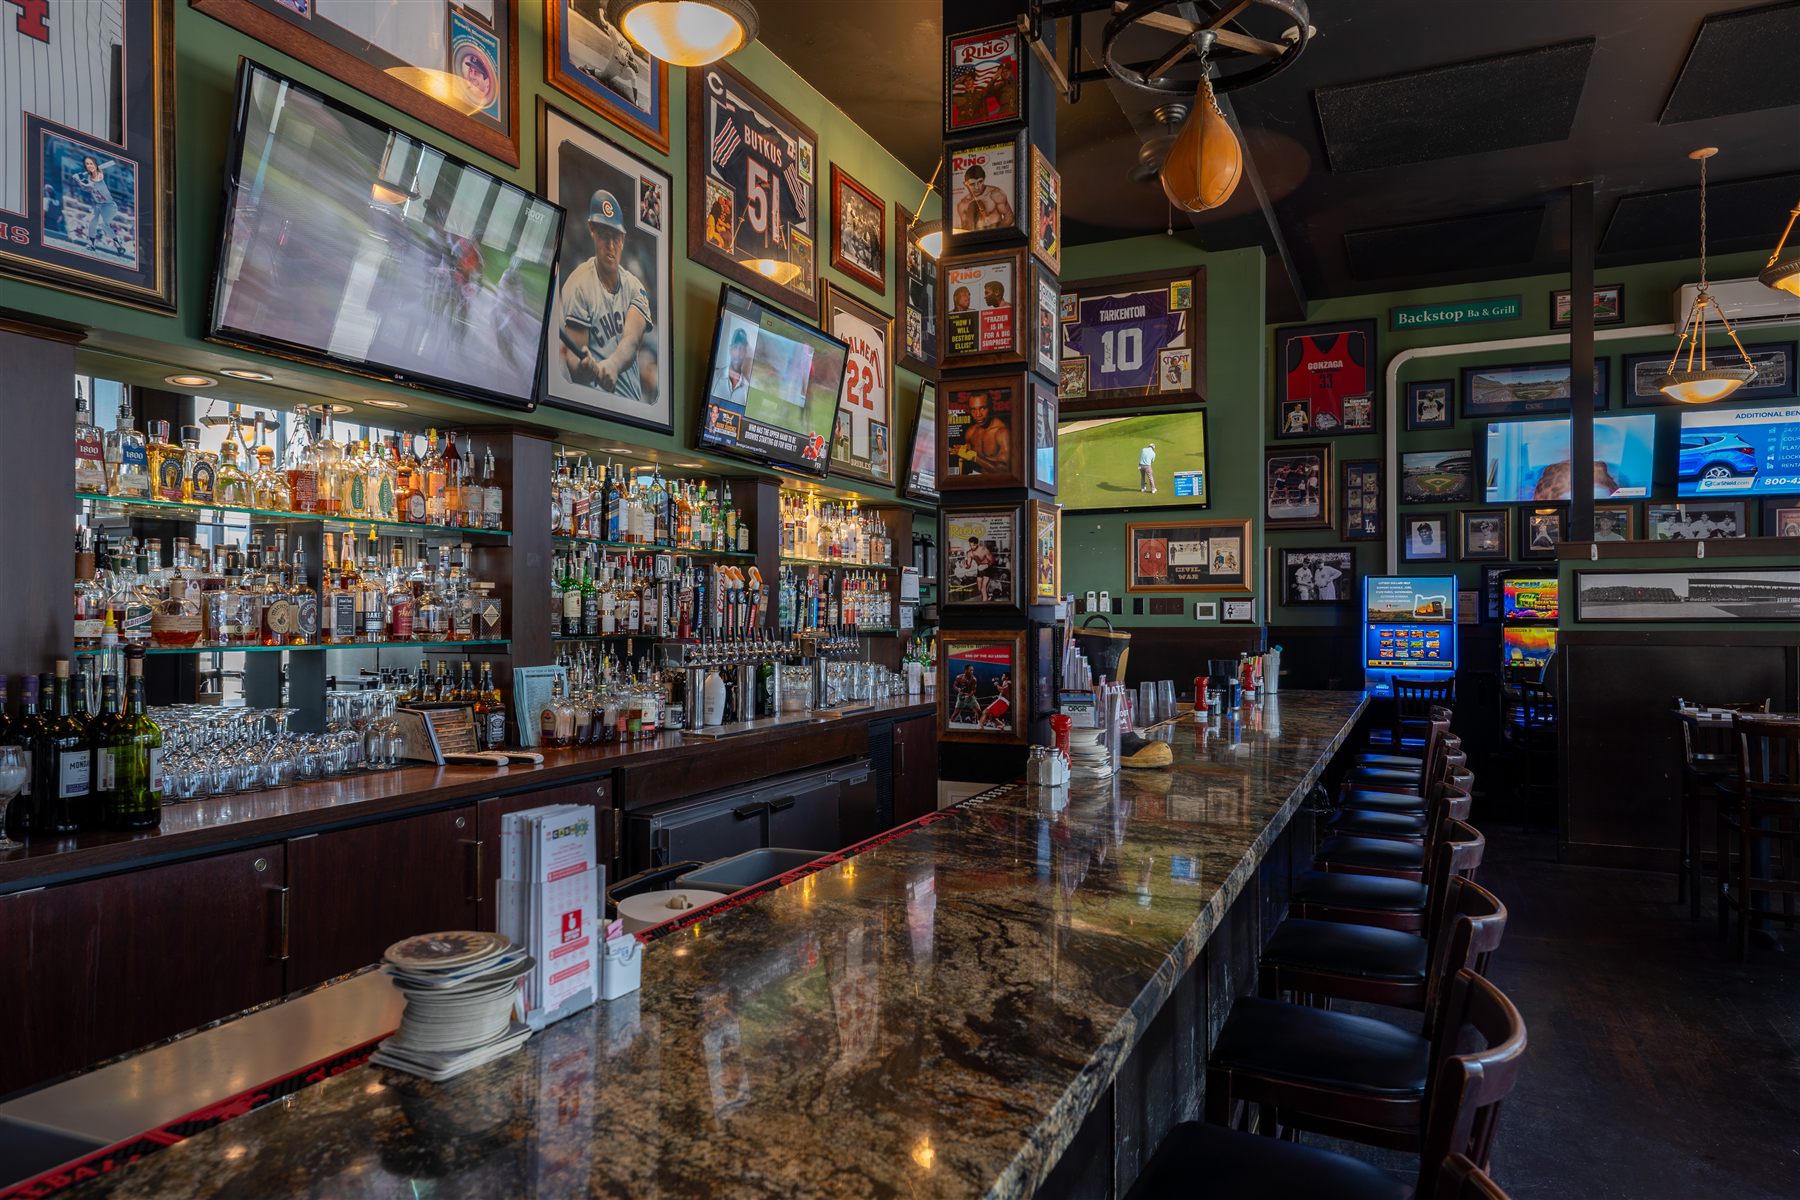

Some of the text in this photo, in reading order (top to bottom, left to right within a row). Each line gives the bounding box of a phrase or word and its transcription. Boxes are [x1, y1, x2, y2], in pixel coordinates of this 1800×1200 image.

[961, 42, 1006, 63] RING
[744, 124, 783, 168] BUTKUS
[952, 156, 986, 172] RING
[746, 156, 781, 244] 51
[524, 207, 546, 222] ROOT
[948, 269, 982, 285] RING
[1099, 305, 1146, 322] TARKENTON
[1398, 305, 1516, 325] Backstop Ba & Grill
[591, 311, 627, 349] CHIC
[951, 334, 975, 343] DESTROY
[1101, 327, 1143, 374] 10
[1307, 360, 1344, 371] GONZAGA
[846, 359, 874, 411] 22
[1319, 373, 1333, 390] 33
[1735, 411, 1784, 419] ADDITIONAL
[79, 445, 99, 455] 1800
[126, 450, 144, 460] 1800
[850, 457, 872, 471] ORIOLES
[1712, 479, 1750, 487] CarShield.com
[1067, 704, 1088, 713] OPGR
